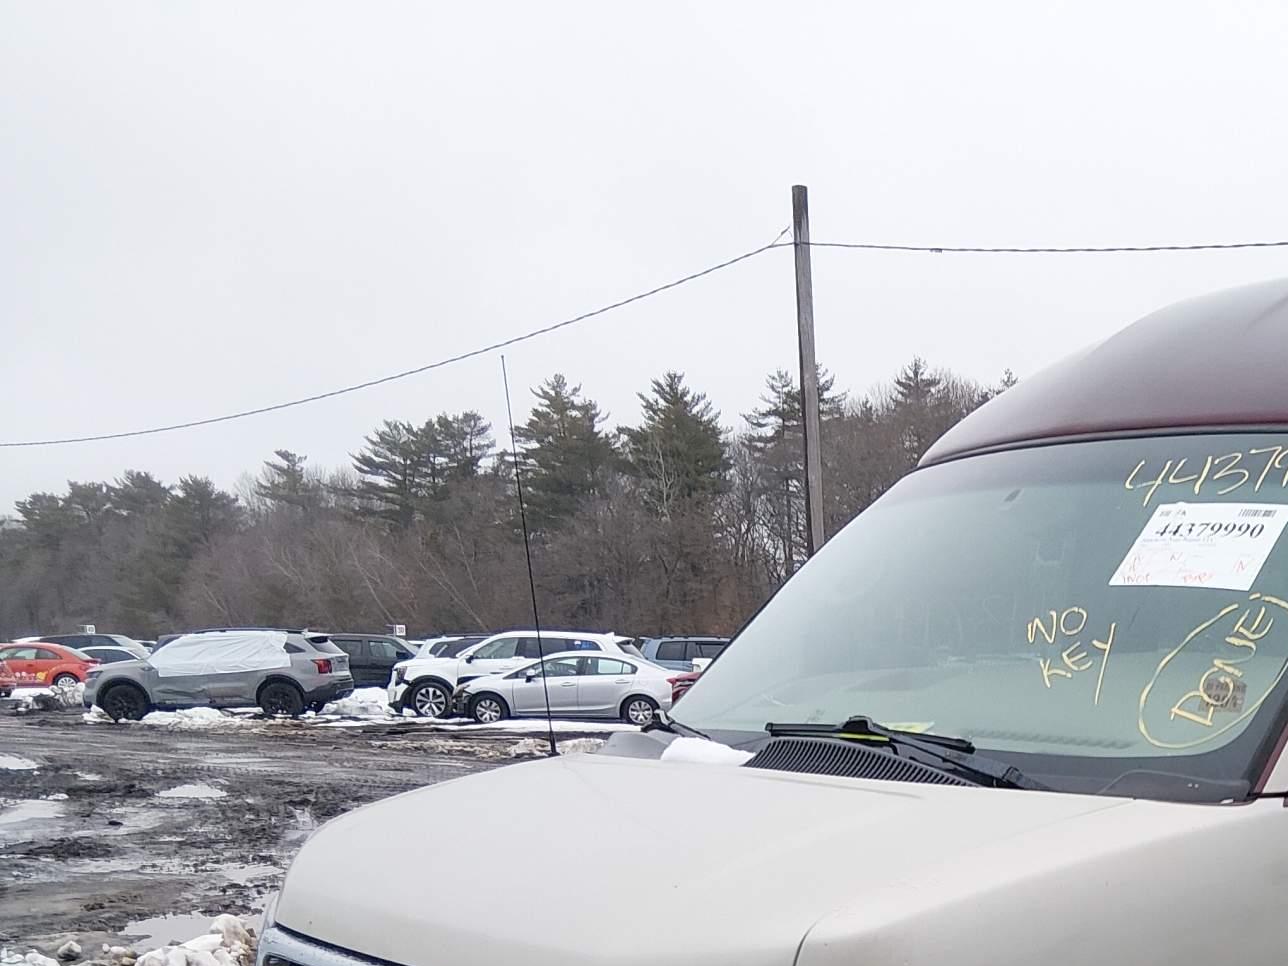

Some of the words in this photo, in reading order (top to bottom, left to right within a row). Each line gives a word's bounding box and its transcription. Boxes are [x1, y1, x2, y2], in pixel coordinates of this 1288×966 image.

[1155, 521, 1265, 538] 44379990
[1026, 607, 1087, 644] NO
[1039, 622, 1116, 704] KEY
[1170, 605, 1274, 726] DONE
